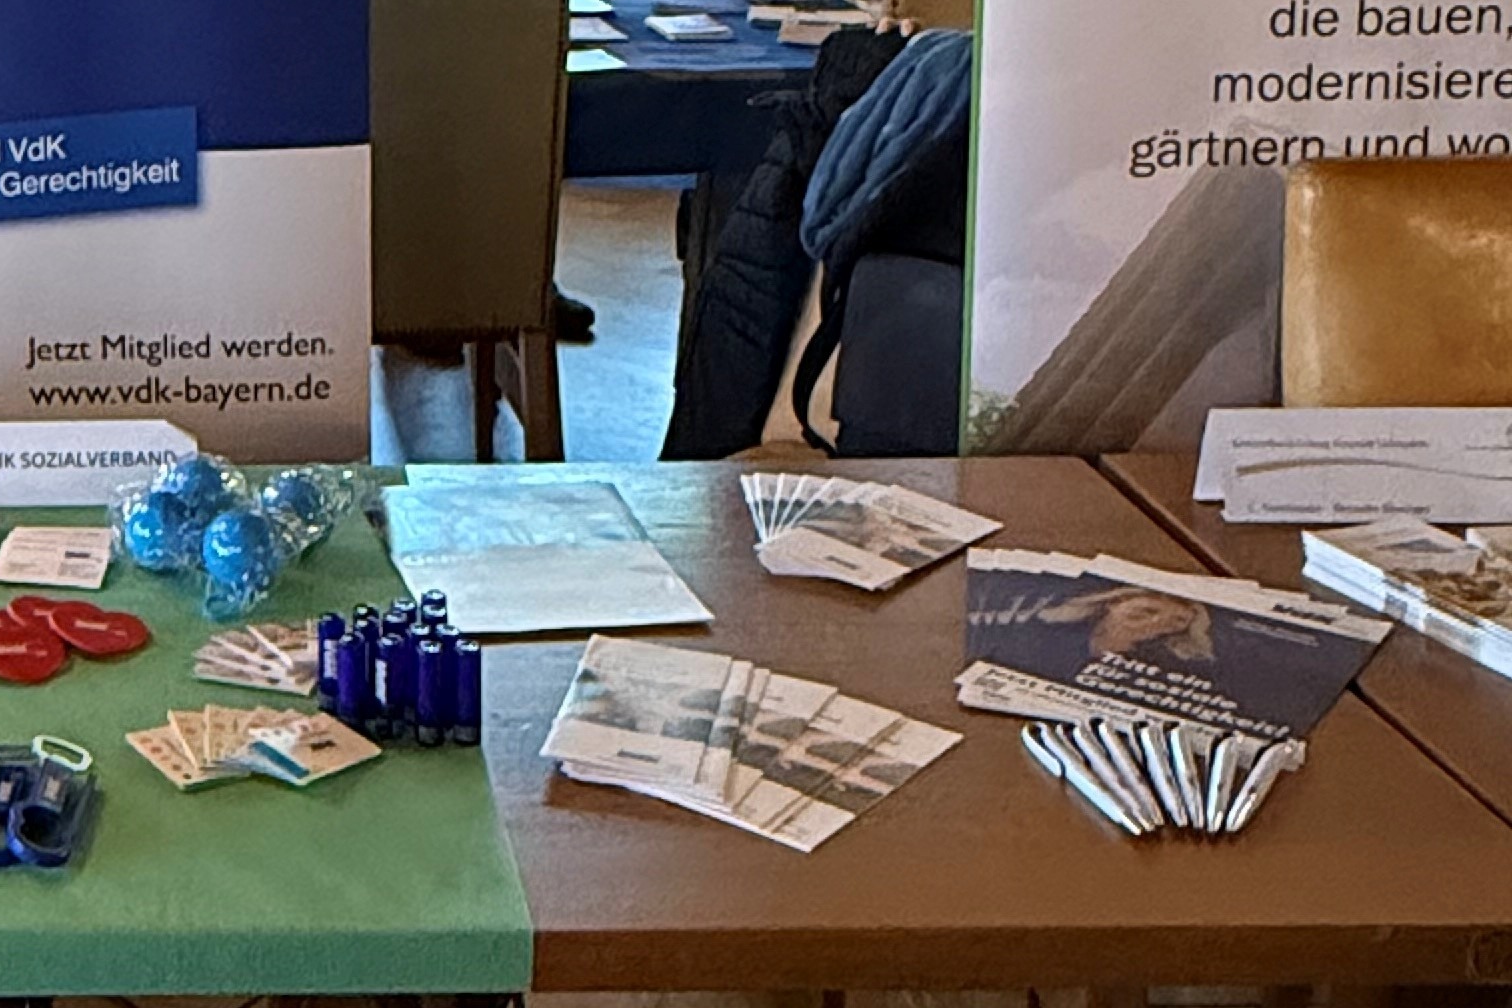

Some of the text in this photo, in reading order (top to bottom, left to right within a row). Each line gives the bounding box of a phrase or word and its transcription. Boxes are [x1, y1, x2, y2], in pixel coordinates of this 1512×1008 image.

[1212, 61, 1512, 103] modernisiere
[8, 134, 66, 162] VdK
[1128, 129, 1325, 178] gärtnern
[1345, 126, 1429, 159] und
[25, 331, 334, 370] Jetzt Mitglied werden.
[30, 374, 330, 410] www.vdk-bayern.de
[20, 450, 177, 469] SOZIALVERBAND
